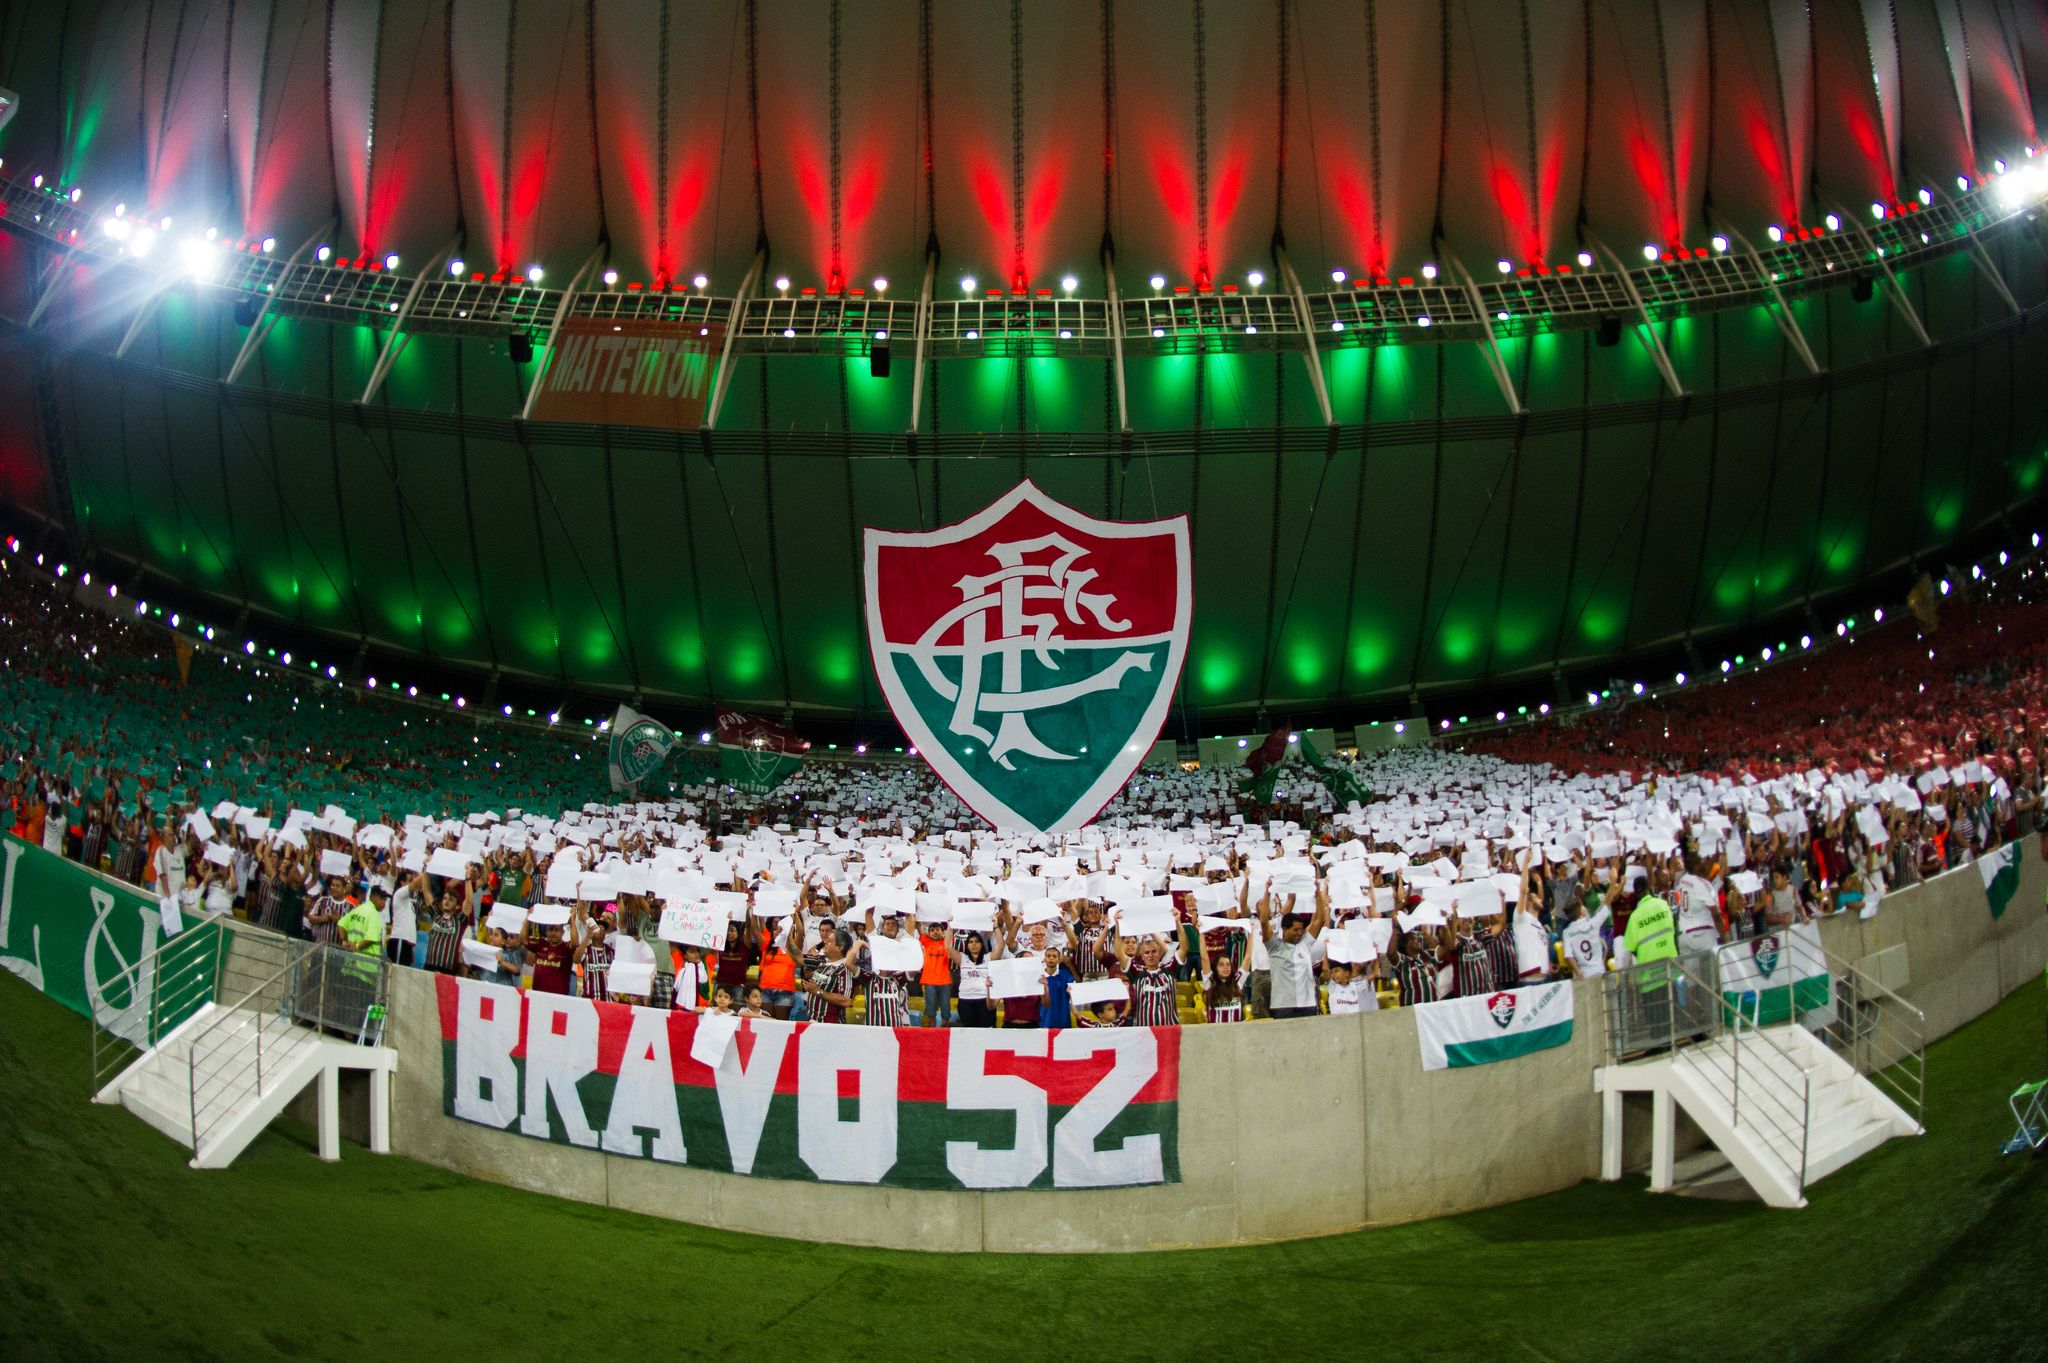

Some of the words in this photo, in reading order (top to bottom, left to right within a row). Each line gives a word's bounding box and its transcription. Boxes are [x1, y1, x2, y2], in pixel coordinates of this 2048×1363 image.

[1580, 940, 1592, 961] 9
[453, 975, 899, 1184] BRAVO
[945, 1026, 1164, 1189] 52
